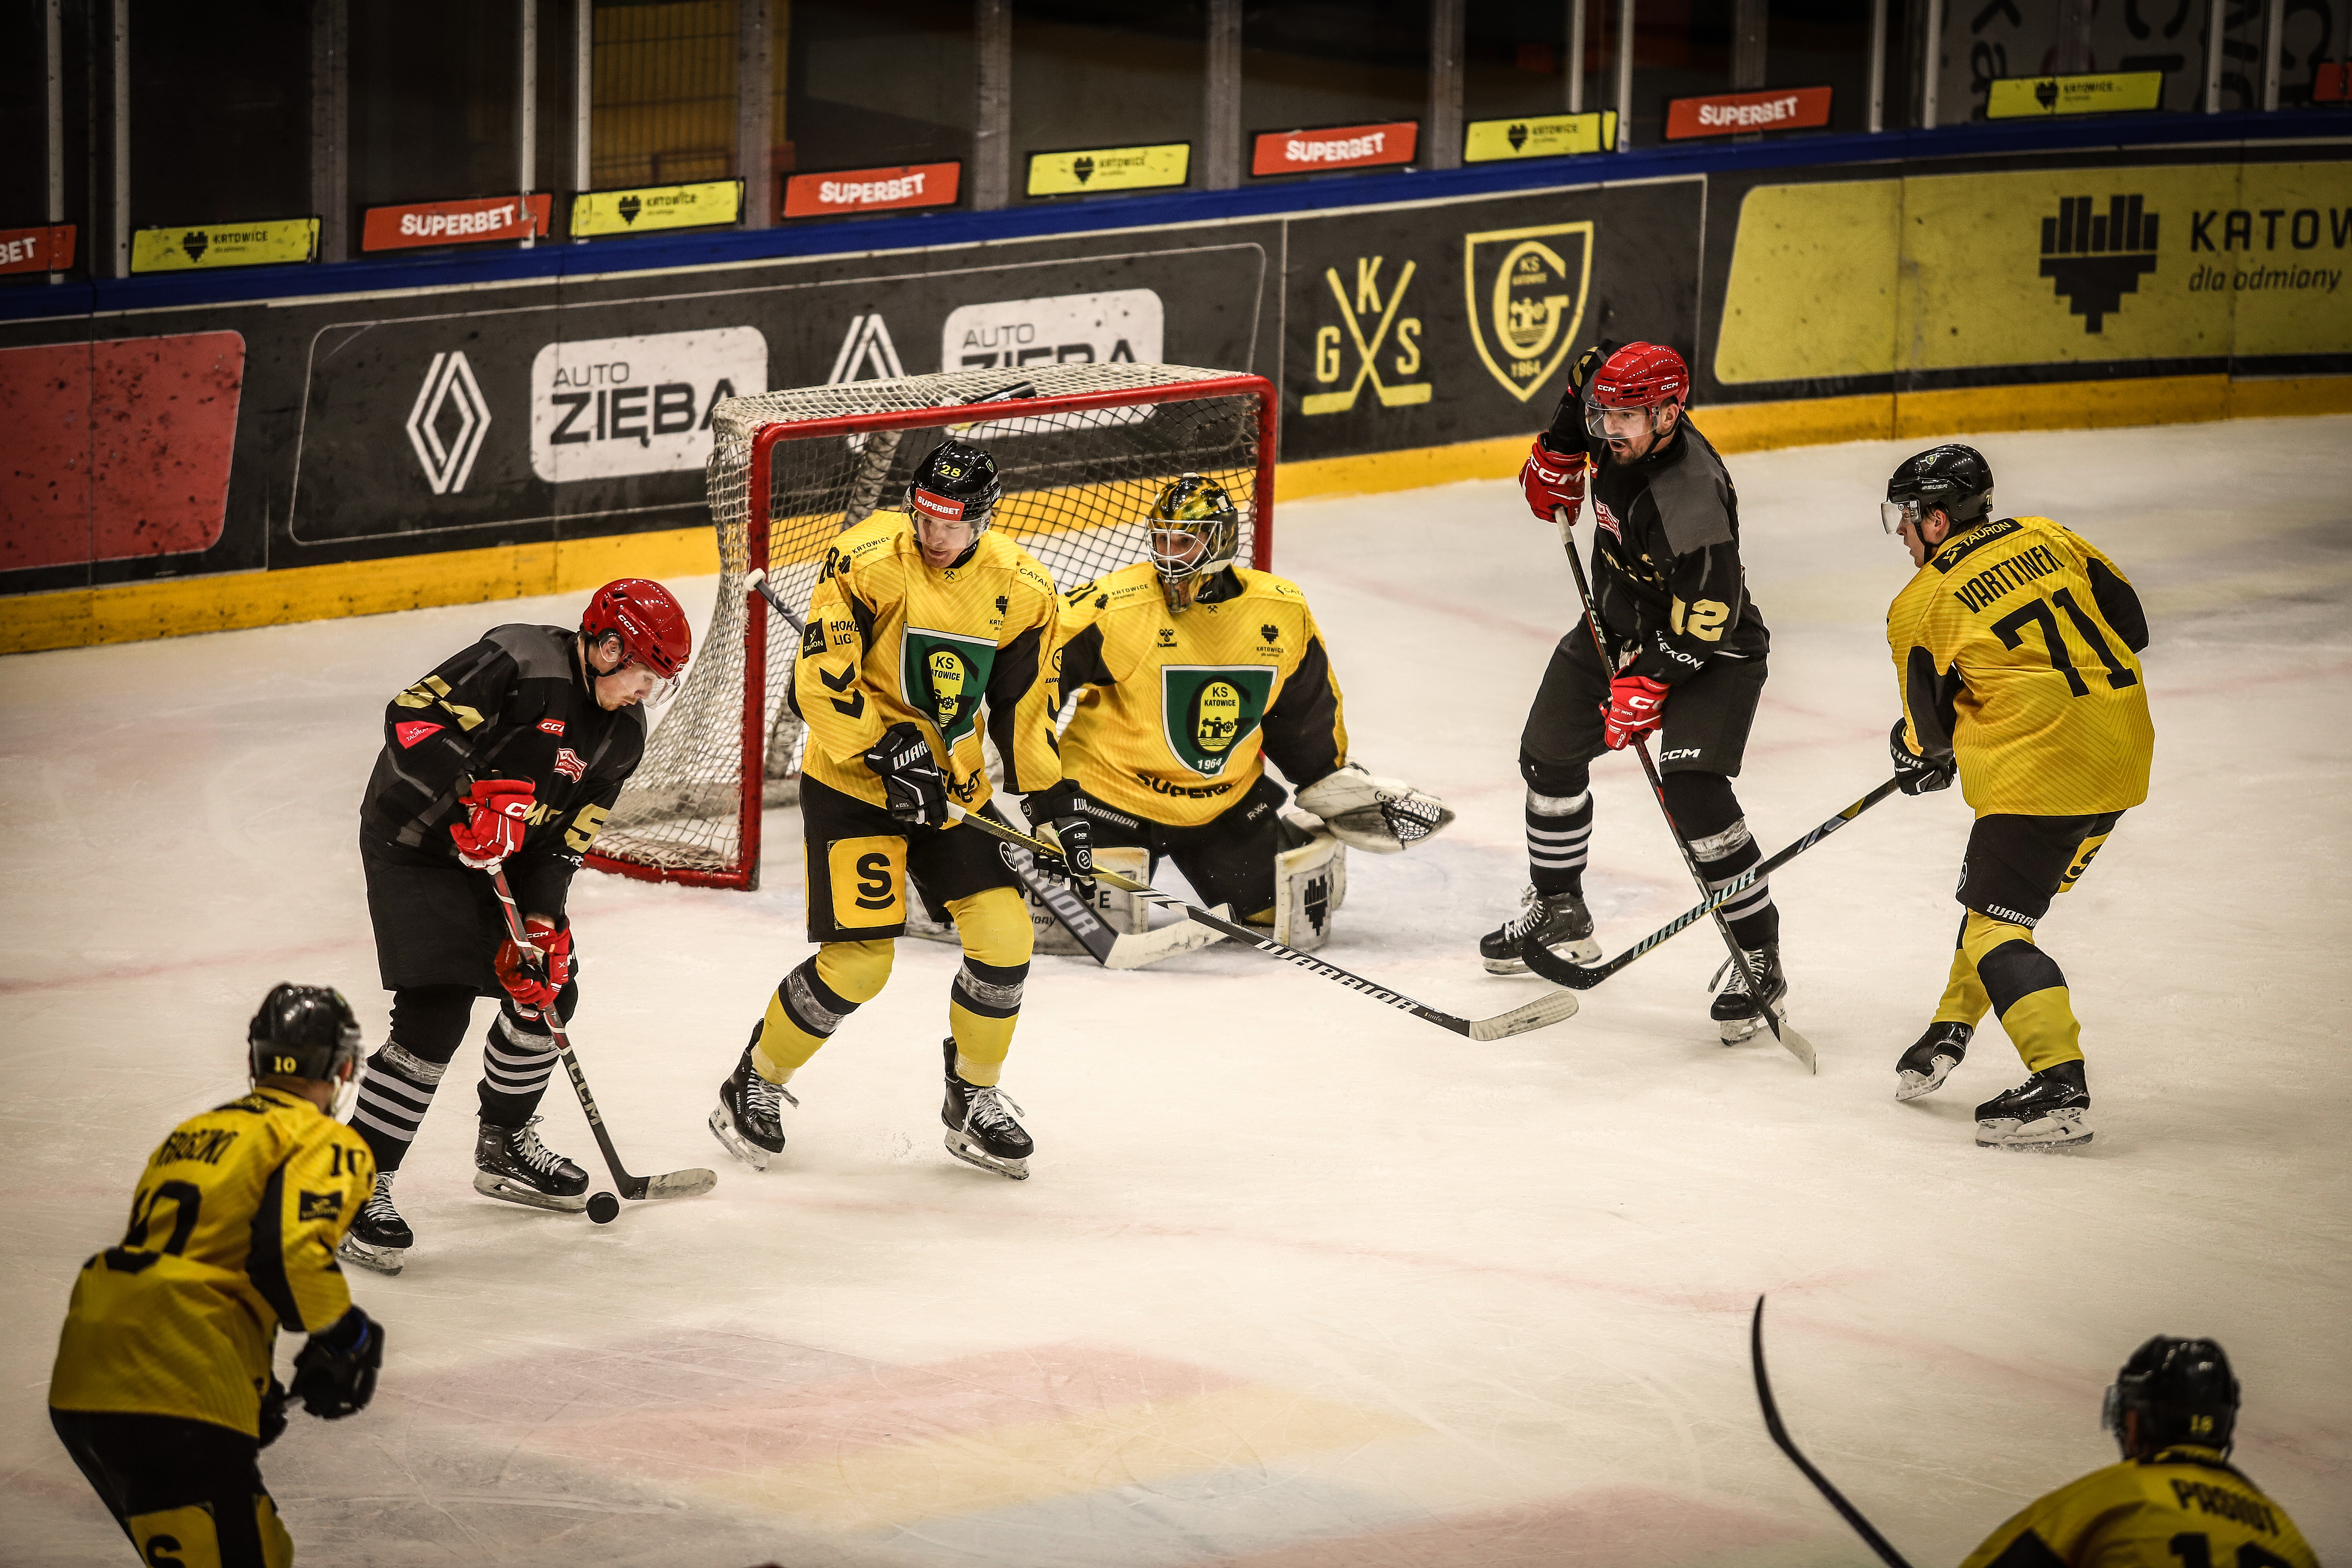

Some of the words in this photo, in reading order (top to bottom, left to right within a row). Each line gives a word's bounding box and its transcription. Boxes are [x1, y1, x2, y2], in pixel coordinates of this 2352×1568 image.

[1698, 96, 1798, 126] SUPERBET
[1285, 132, 1385, 162] SUPERBET
[818, 172, 926, 204] SUPERBET
[401, 205, 515, 236] SUPERBET
[213, 230, 269, 244] KATOWICE
[2189, 263, 2225, 292] dla
[2233, 263, 2342, 294] odmiany
[963, 323, 1035, 349] AUTO
[553, 362, 629, 387] AUTO
[1661, 381, 1678, 390] CCM
[940, 465, 961, 477] 28
[1530, 453, 1583, 485] CCM
[917, 496, 960, 516] SUPERBET
[852, 537, 891, 554] KATOWICE
[1960, 522, 2012, 546] TAURON
[1112, 584, 1149, 596] KATOWICE
[1953, 543, 2066, 614] VARTTINEN
[618, 614, 639, 635] CCM
[1670, 594, 1730, 641] 12
[1989, 586, 2138, 698] 71
[936, 655, 954, 669] KS
[1213, 686, 1228, 697] KS
[1197, 757, 1222, 769] 1964
[1660, 748, 1701, 763] CCM
[1254, 940, 1419, 1013] WARRIOR
[274, 1056, 297, 1073] 10
[568, 1062, 602, 1125] CCM
